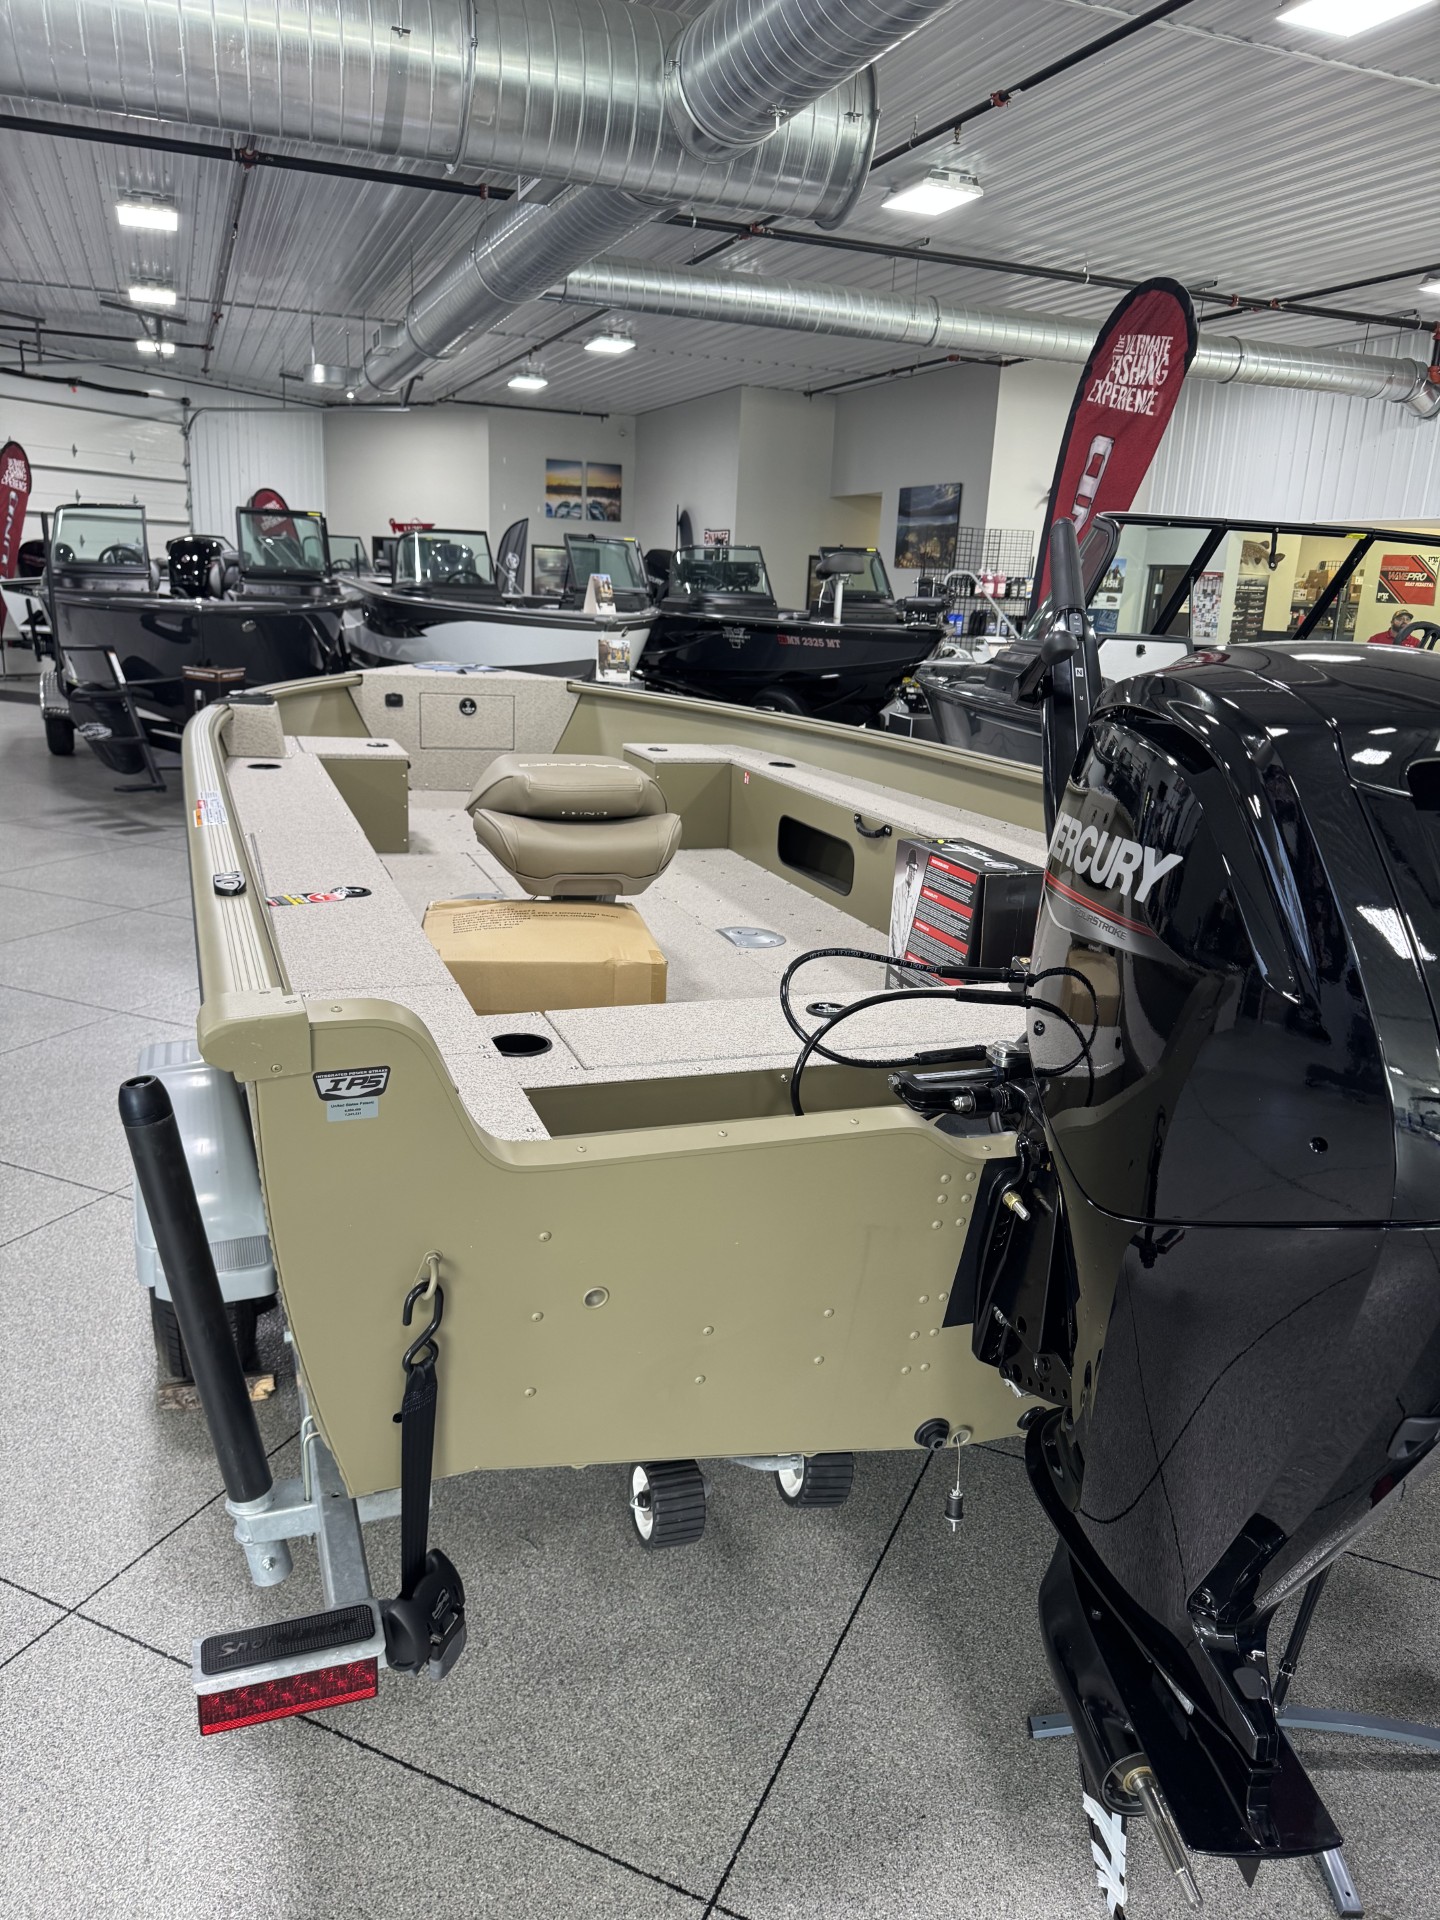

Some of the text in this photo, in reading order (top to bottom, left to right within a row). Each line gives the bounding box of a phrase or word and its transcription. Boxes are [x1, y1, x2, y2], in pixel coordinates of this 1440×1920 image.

[1113, 334, 1174, 358] The ULTIMATE
[1105, 354, 1169, 386] FISHING
[1086, 378, 1159, 416] EXPERIENCE
[786, 635, 800, 645] MN
[827, 638, 841, 648] MT
[1074, 906, 1128, 941] FOURSTROKE
[324, 1074, 385, 1092] IPS
